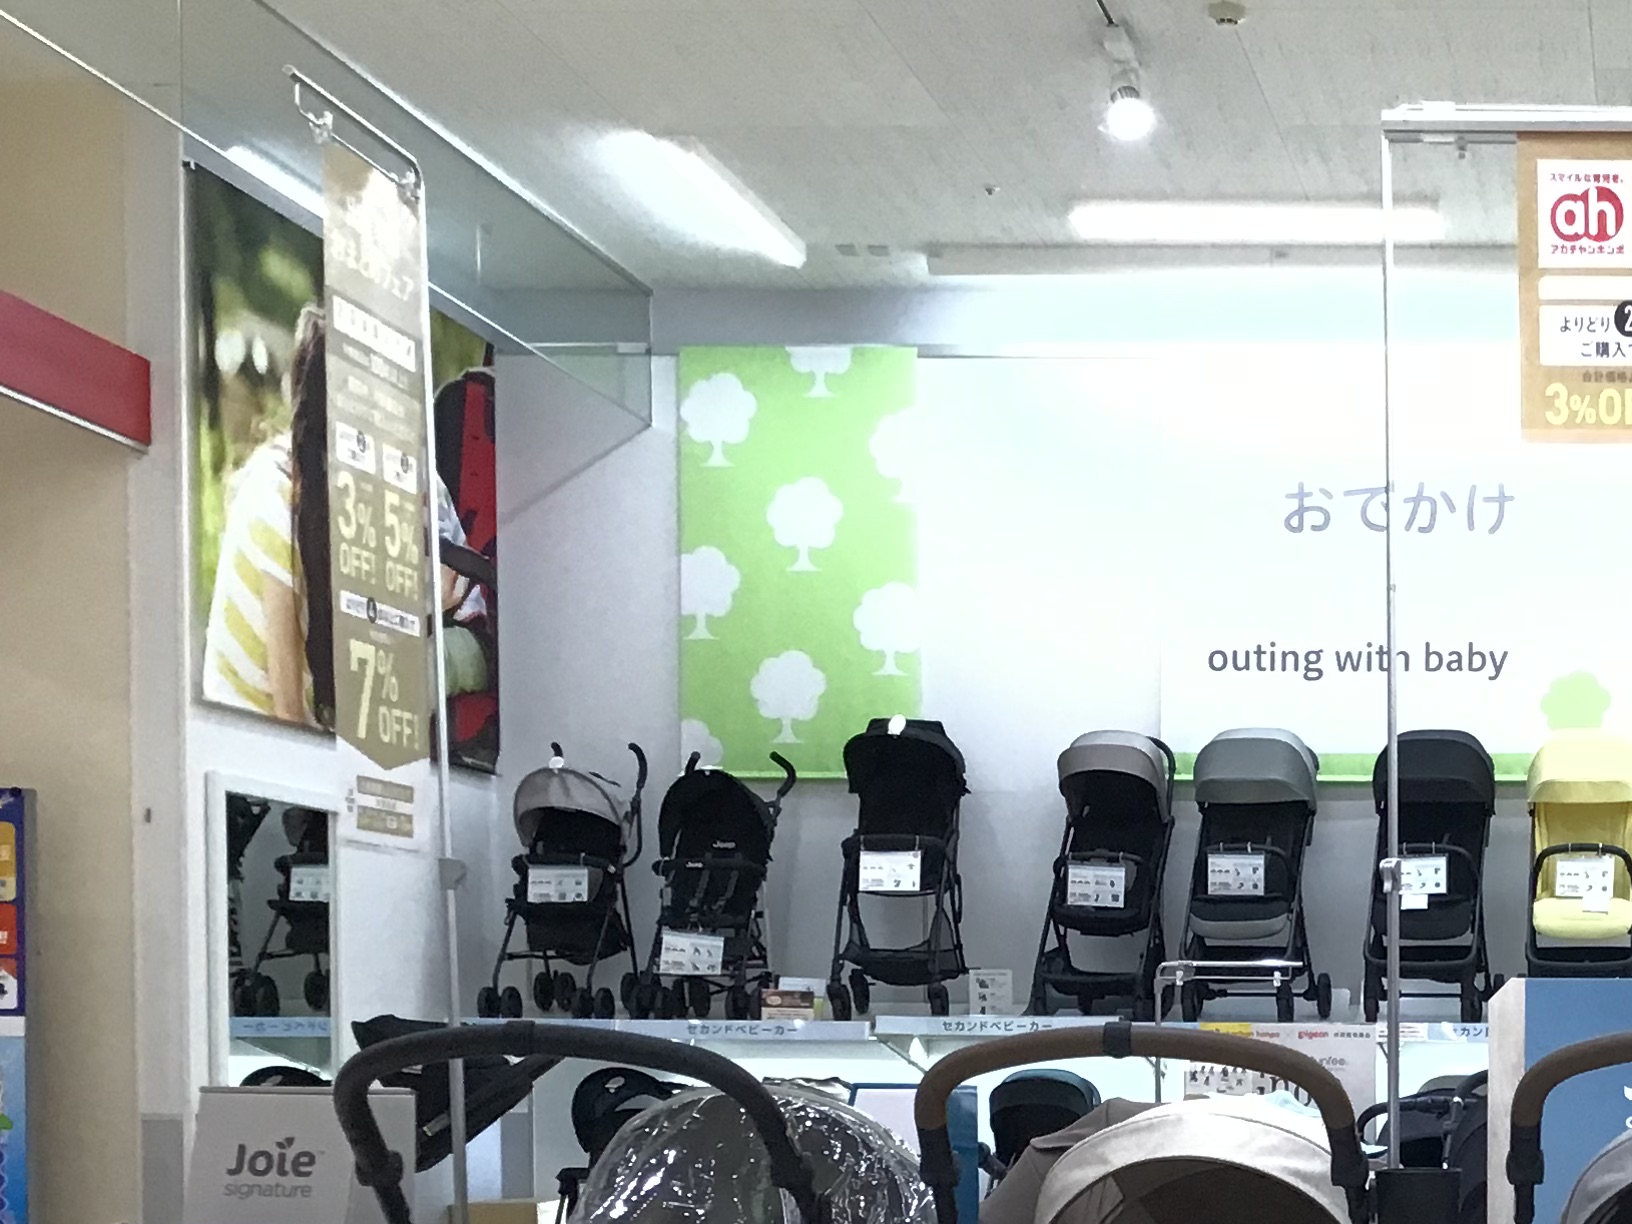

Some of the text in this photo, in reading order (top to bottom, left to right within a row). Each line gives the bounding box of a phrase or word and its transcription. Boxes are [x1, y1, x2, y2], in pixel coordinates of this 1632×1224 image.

[1283, 481, 1515, 535] おでかけ
[1208, 641, 1324, 681] outing
[1424, 642, 1509, 681] baby
[686, 1023, 798, 1036] セカンドベビーカー
[942, 1021, 1053, 1032] セカンドベビーカー
[226, 1136, 316, 1178] Joie
[223, 1182, 312, 1200] signature
